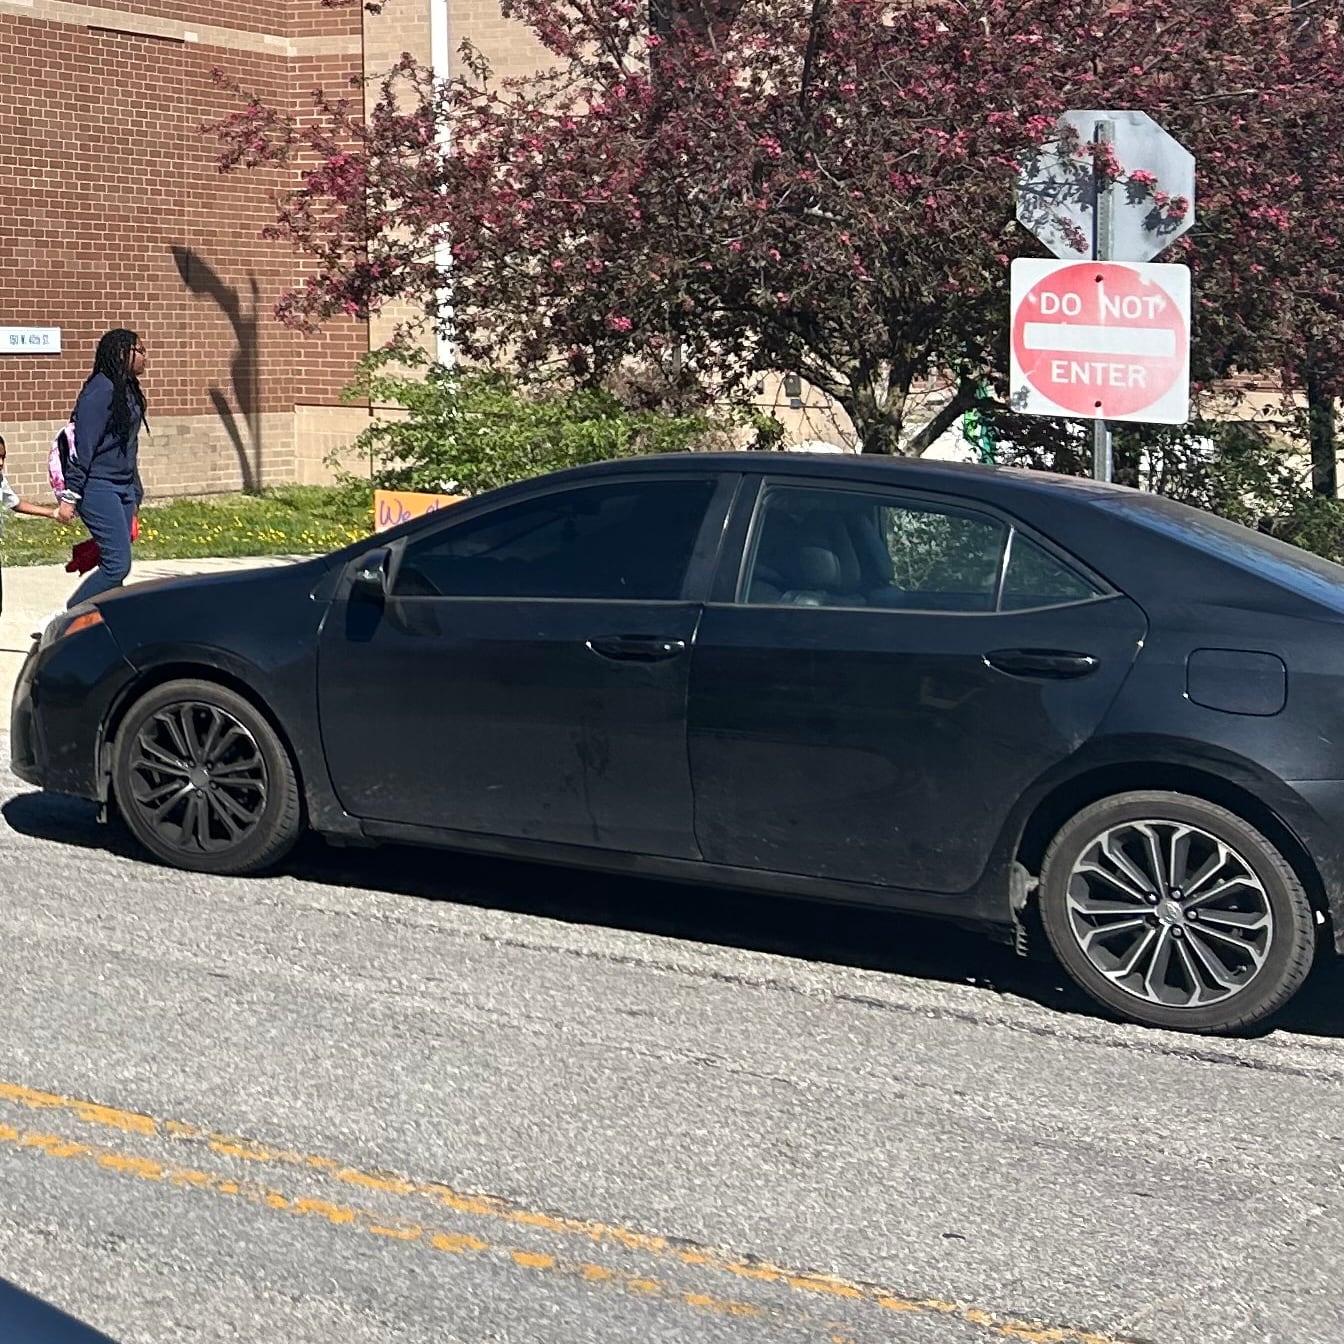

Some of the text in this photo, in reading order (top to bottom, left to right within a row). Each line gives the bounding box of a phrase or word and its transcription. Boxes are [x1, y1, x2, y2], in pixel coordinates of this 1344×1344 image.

[1039, 291, 1160, 320] DO NOT
[1050, 360, 1147, 389] ENTER
[380, 498, 411, 525] We
